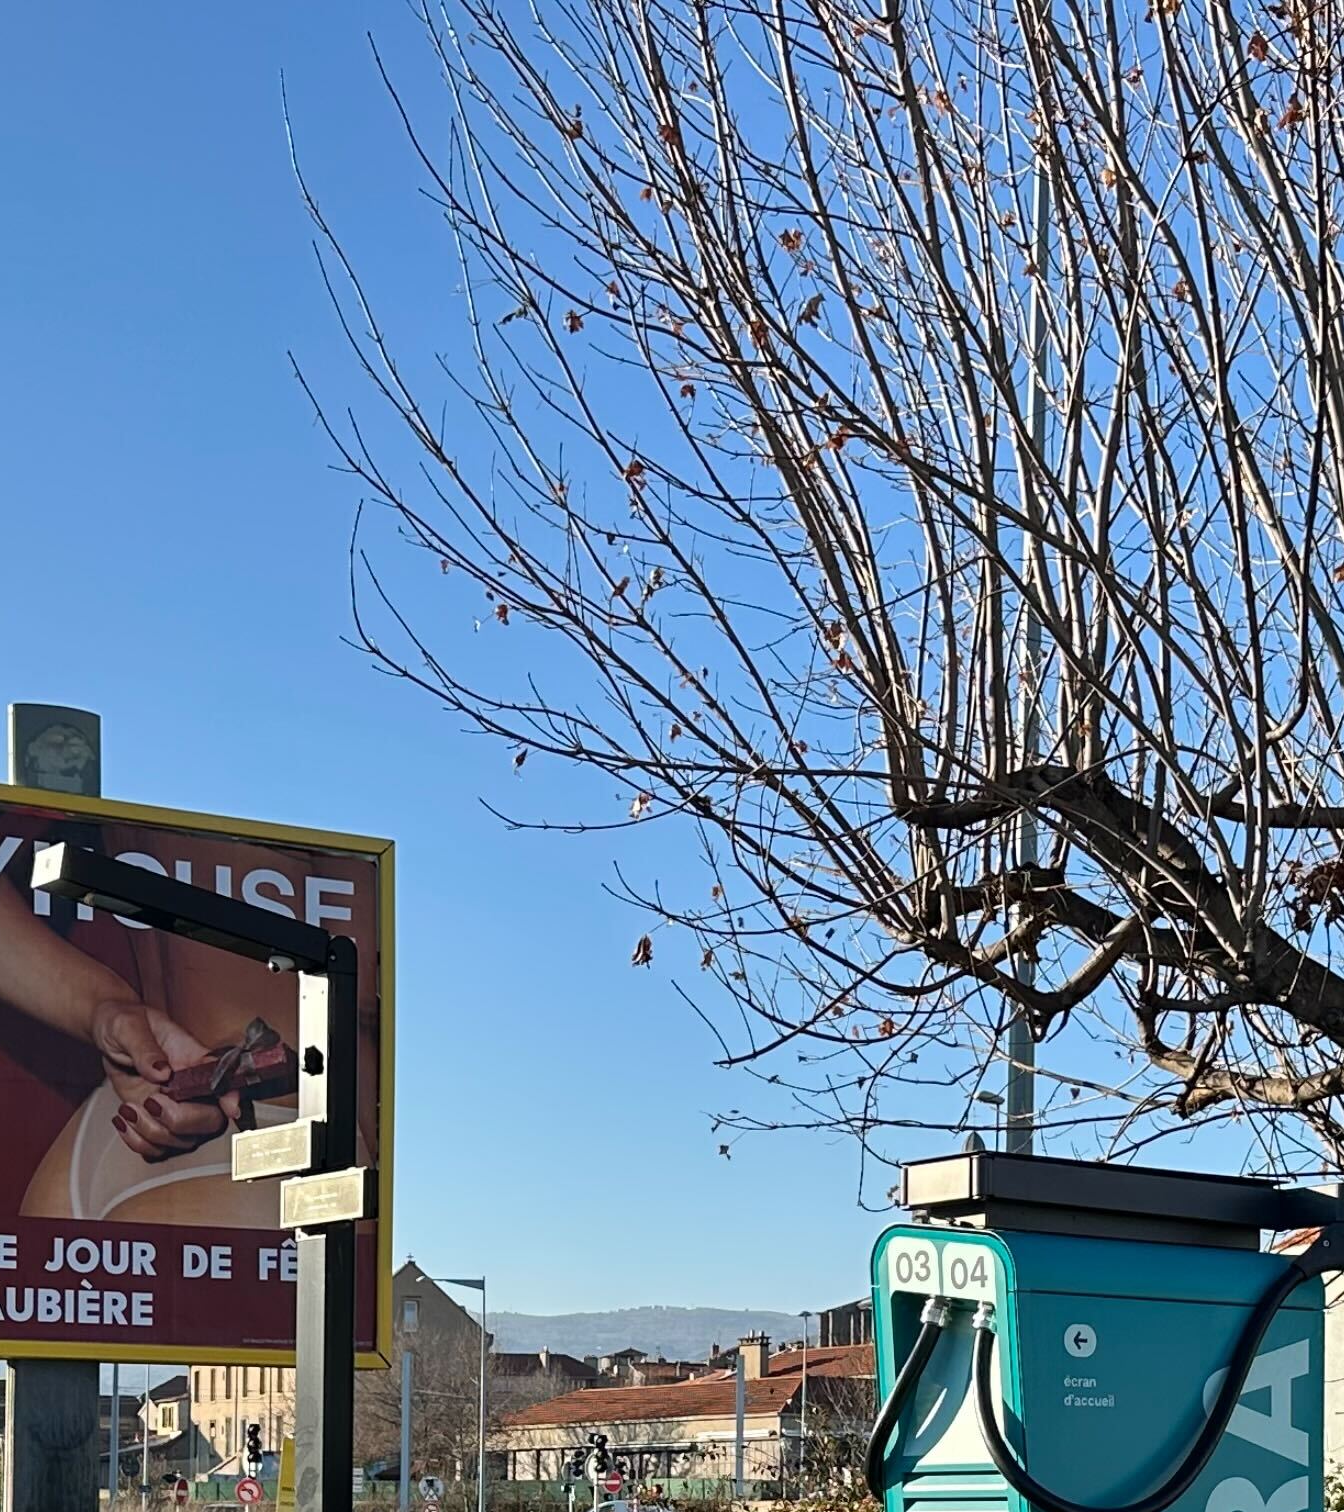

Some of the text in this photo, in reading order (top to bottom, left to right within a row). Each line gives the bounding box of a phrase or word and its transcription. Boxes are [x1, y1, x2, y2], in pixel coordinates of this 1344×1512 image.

[44, 1237, 157, 1277] JOUR
[183, 1244, 232, 1279] DE
[258, 1238, 298, 1281] FÊ
[896, 1250, 931, 1284] 03
[950, 1255, 988, 1290] 04
[1064, 1376, 1096, 1388] écran
[1064, 1394, 1115, 1407] d'accueil
